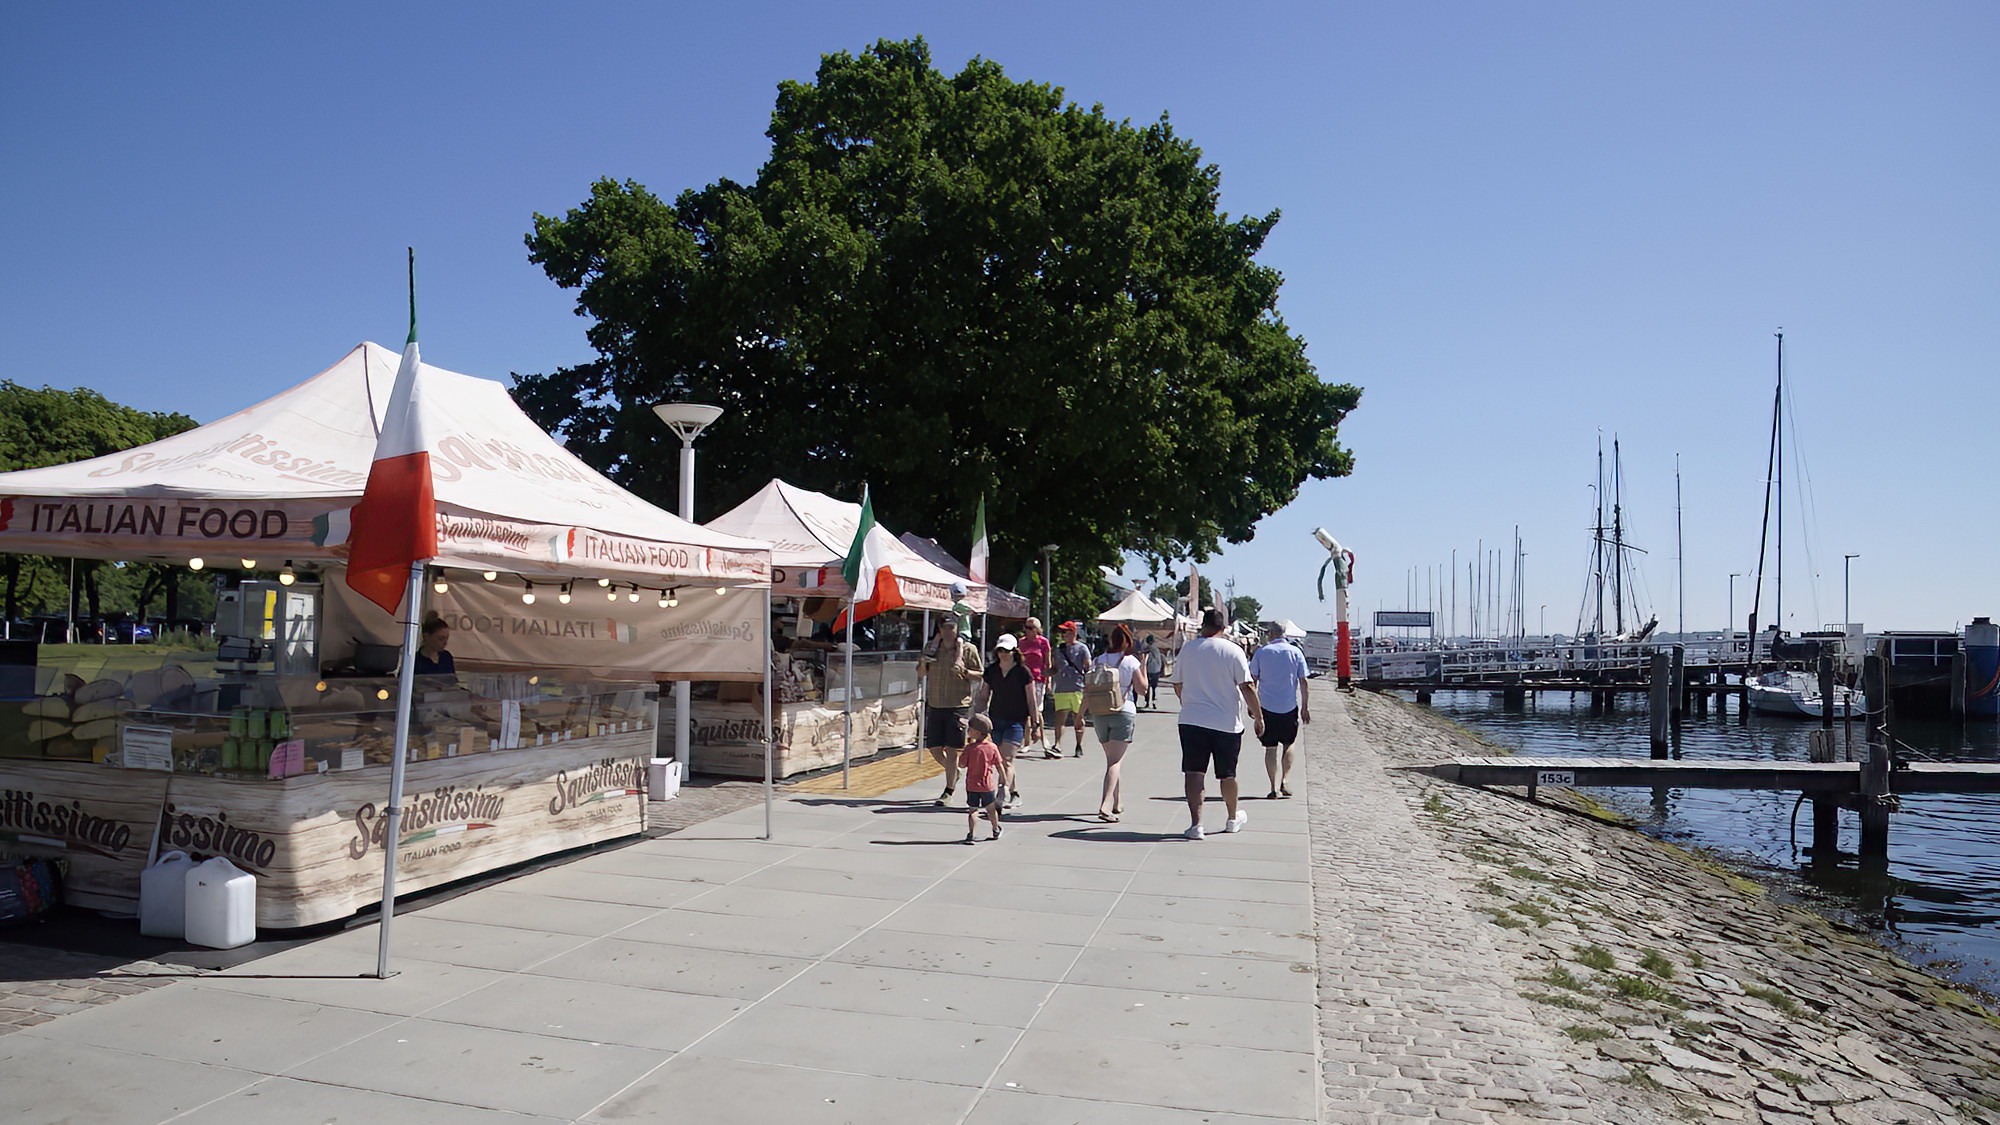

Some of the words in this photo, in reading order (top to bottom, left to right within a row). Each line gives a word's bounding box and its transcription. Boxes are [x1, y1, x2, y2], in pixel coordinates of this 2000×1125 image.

[31, 504, 166, 536] ITALIAN
[177, 506, 288, 539] FOOD
[585, 535, 646, 566] ITALIAN
[650, 546, 689, 569] FOOD
[1540, 773, 1571, 784] 153c
[403, 846, 438, 863] ITALIAN
